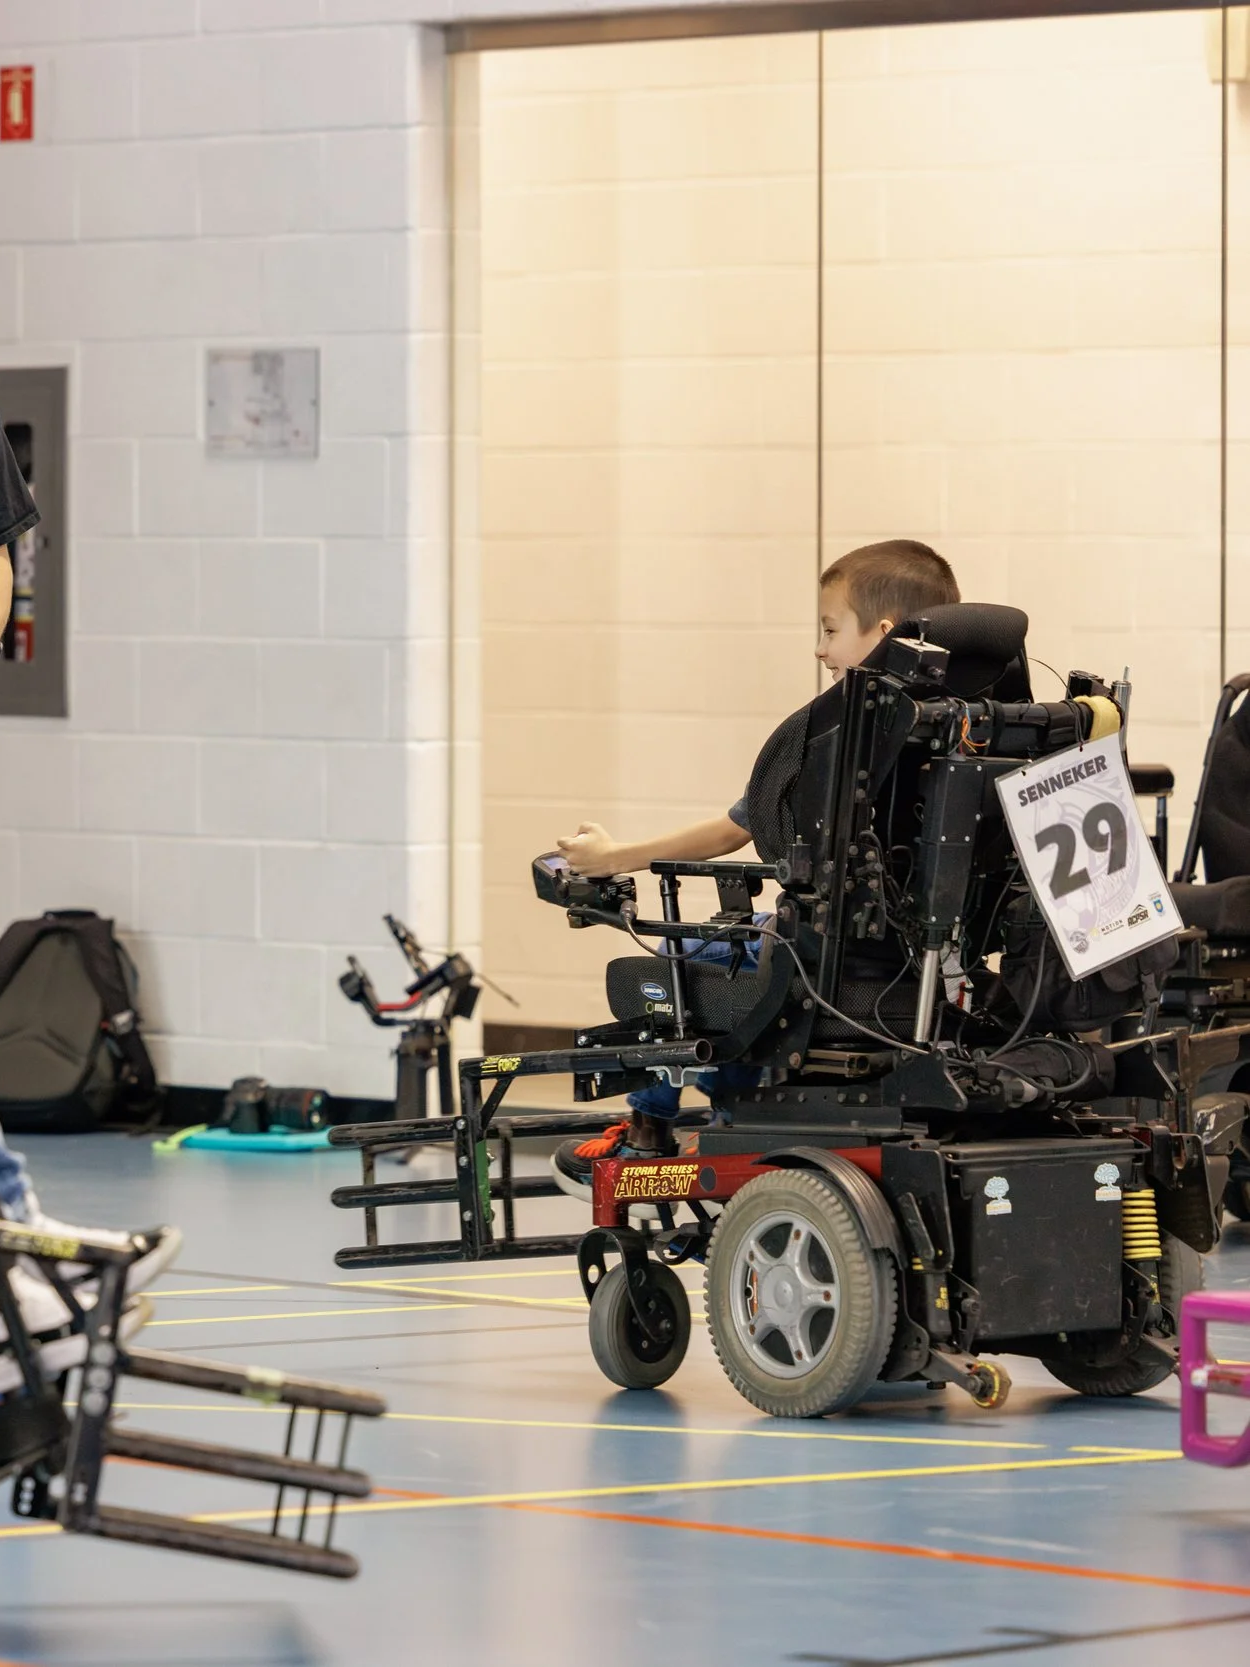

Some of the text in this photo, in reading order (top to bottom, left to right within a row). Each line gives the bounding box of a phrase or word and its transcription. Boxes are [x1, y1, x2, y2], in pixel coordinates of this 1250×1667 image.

[1017, 754, 1107, 807] SENNEKER
[1035, 802, 1127, 900] 29
[614, 1174, 694, 1197] ARROW
[621, 1166, 658, 1176] STORM
